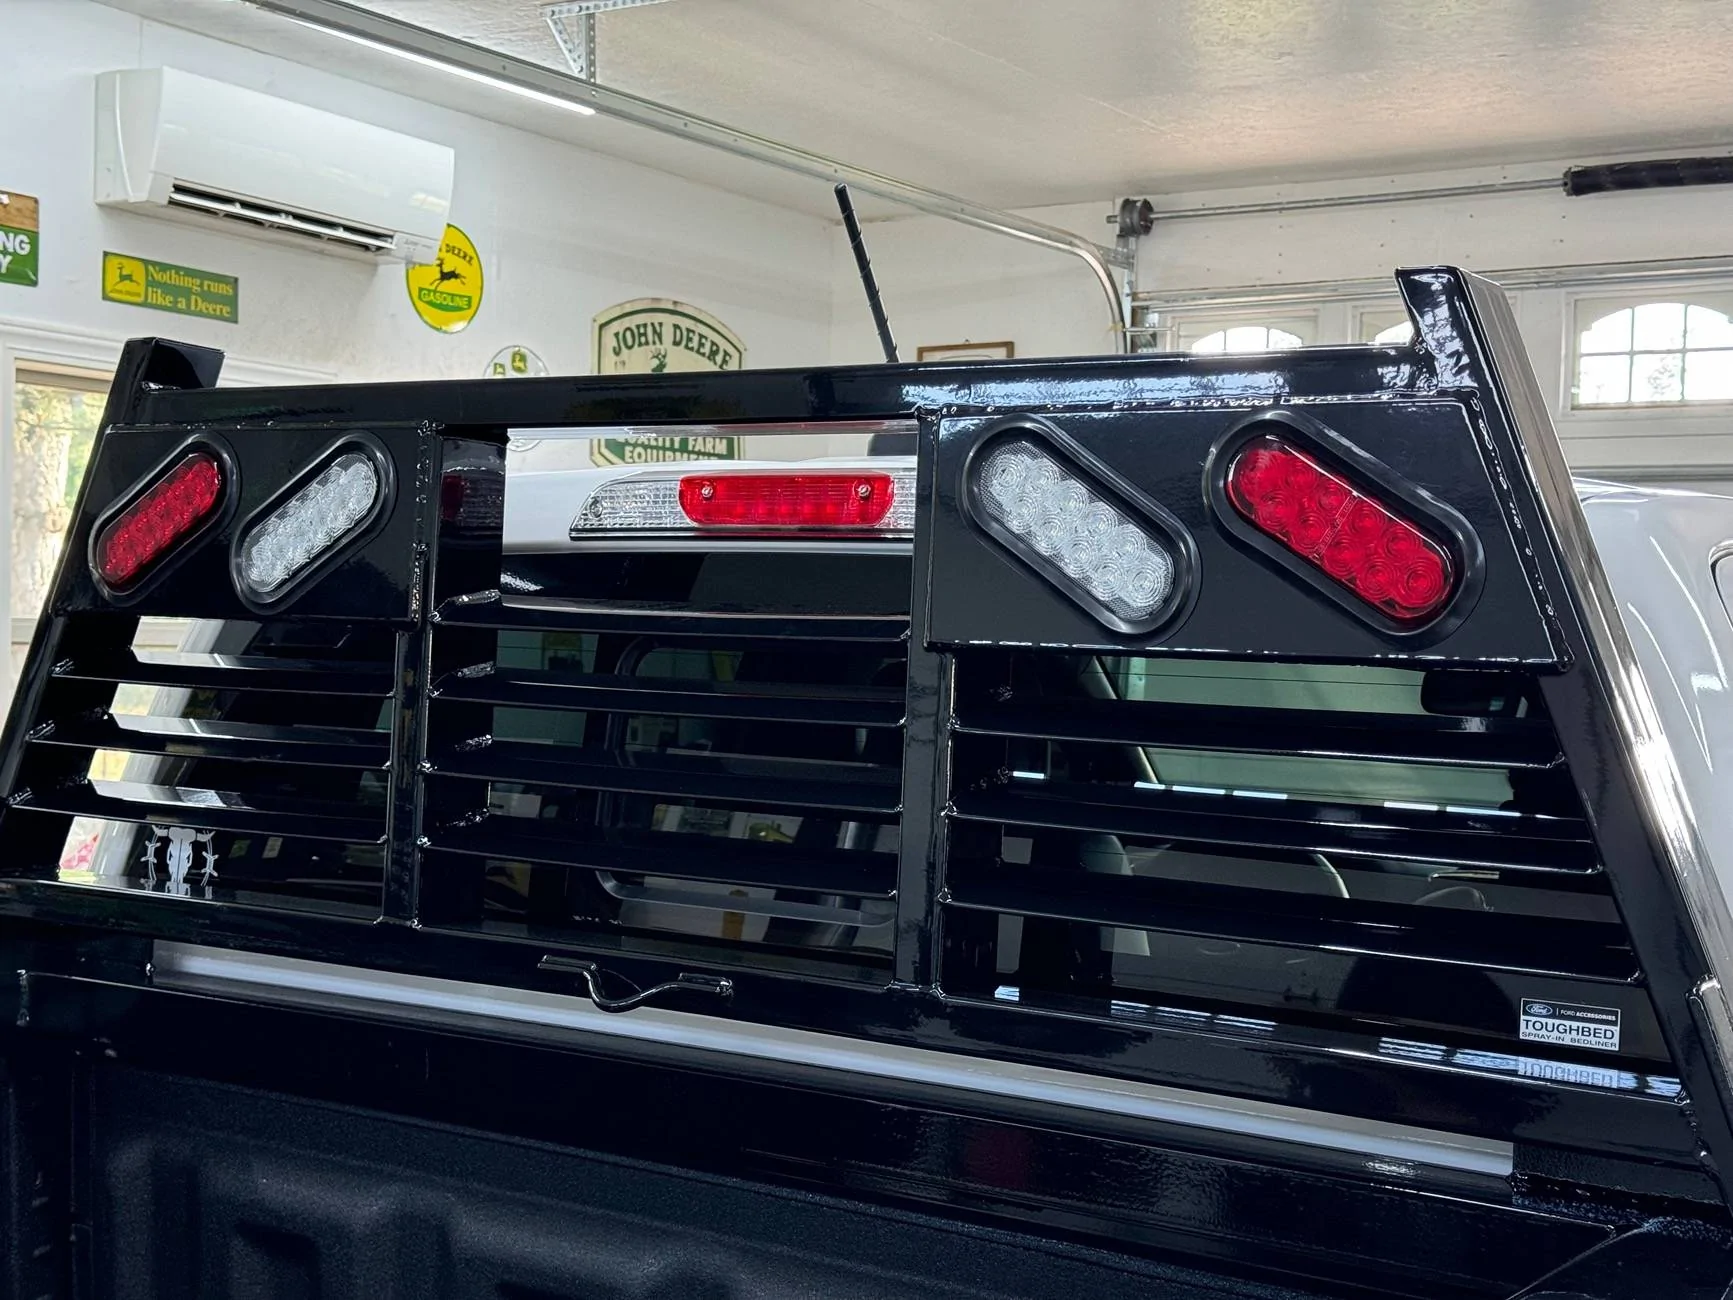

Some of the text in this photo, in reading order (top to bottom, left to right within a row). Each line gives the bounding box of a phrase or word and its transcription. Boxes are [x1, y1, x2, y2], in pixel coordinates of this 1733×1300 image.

[147, 264, 234, 296] Nothing runs
[147, 286, 173, 307] like
[177, 297, 187, 310] a
[190, 294, 231, 317] Deere
[421, 289, 469, 309] GASOLINE
[612, 321, 732, 370] JOHN DEERE
[687, 436, 728, 455] FARM
[1529, 1004, 1549, 1015] Ford
[1575, 1012, 1616, 1021] ACCESSORIES
[1523, 1019, 1615, 1040] TOUGHBED
[1521, 1031, 1617, 1049] SPRAY-IN BEDLINER
